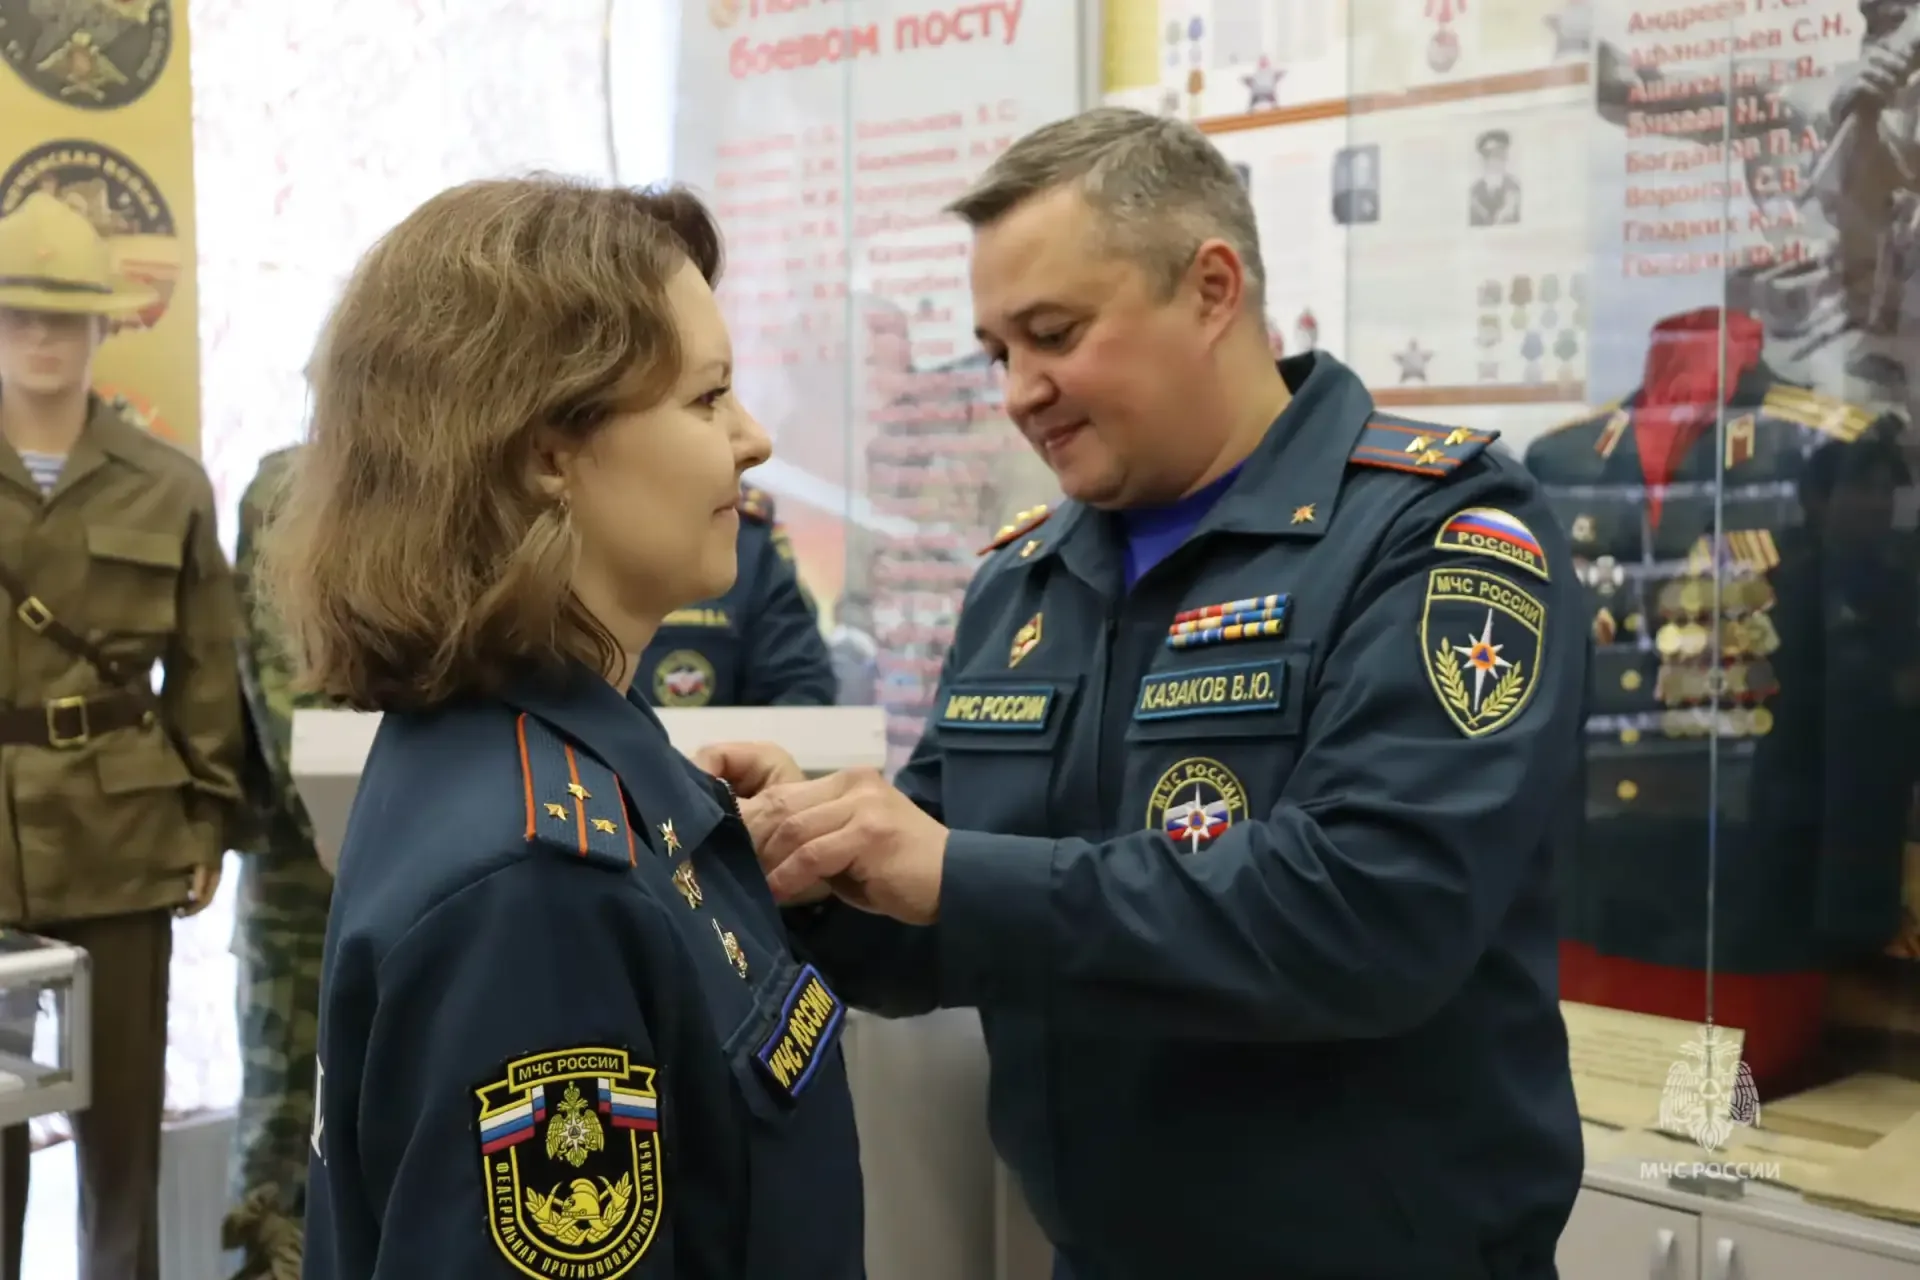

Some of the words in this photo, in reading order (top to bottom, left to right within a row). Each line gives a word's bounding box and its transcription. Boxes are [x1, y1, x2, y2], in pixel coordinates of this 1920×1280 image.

[729, 25, 878, 80] боевом
[896, 0, 1022, 52] посту
[1793, 14, 1851, 42] С.Н.
[1457, 531, 1535, 566] РОССИЯ
[1436, 575, 1475, 594] МЧС
[1479, 583, 1541, 623] РОССИИ
[944, 695, 981, 720] МЧС
[979, 695, 1047, 721] РОССИИ
[1141, 677, 1225, 710] КАЗАКОВ
[1231, 671, 1275, 700] В.Ю.
[1153, 771, 1182, 809] МЧС
[1185, 763, 1243, 809] РОССИИ
[768, 1035, 804, 1088] МЧС
[789, 977, 834, 1057] РОССИИ
[518, 1061, 553, 1081] МЧС
[557, 1055, 620, 1072] РОССИИ
[495, 1161, 538, 1264] ФЕДЕРАЛЬНАЯ
[542, 1209, 654, 1279] ПРОТИВОПОЖАРНАЯ
[638, 1140, 656, 1202] СЛУЖБА
